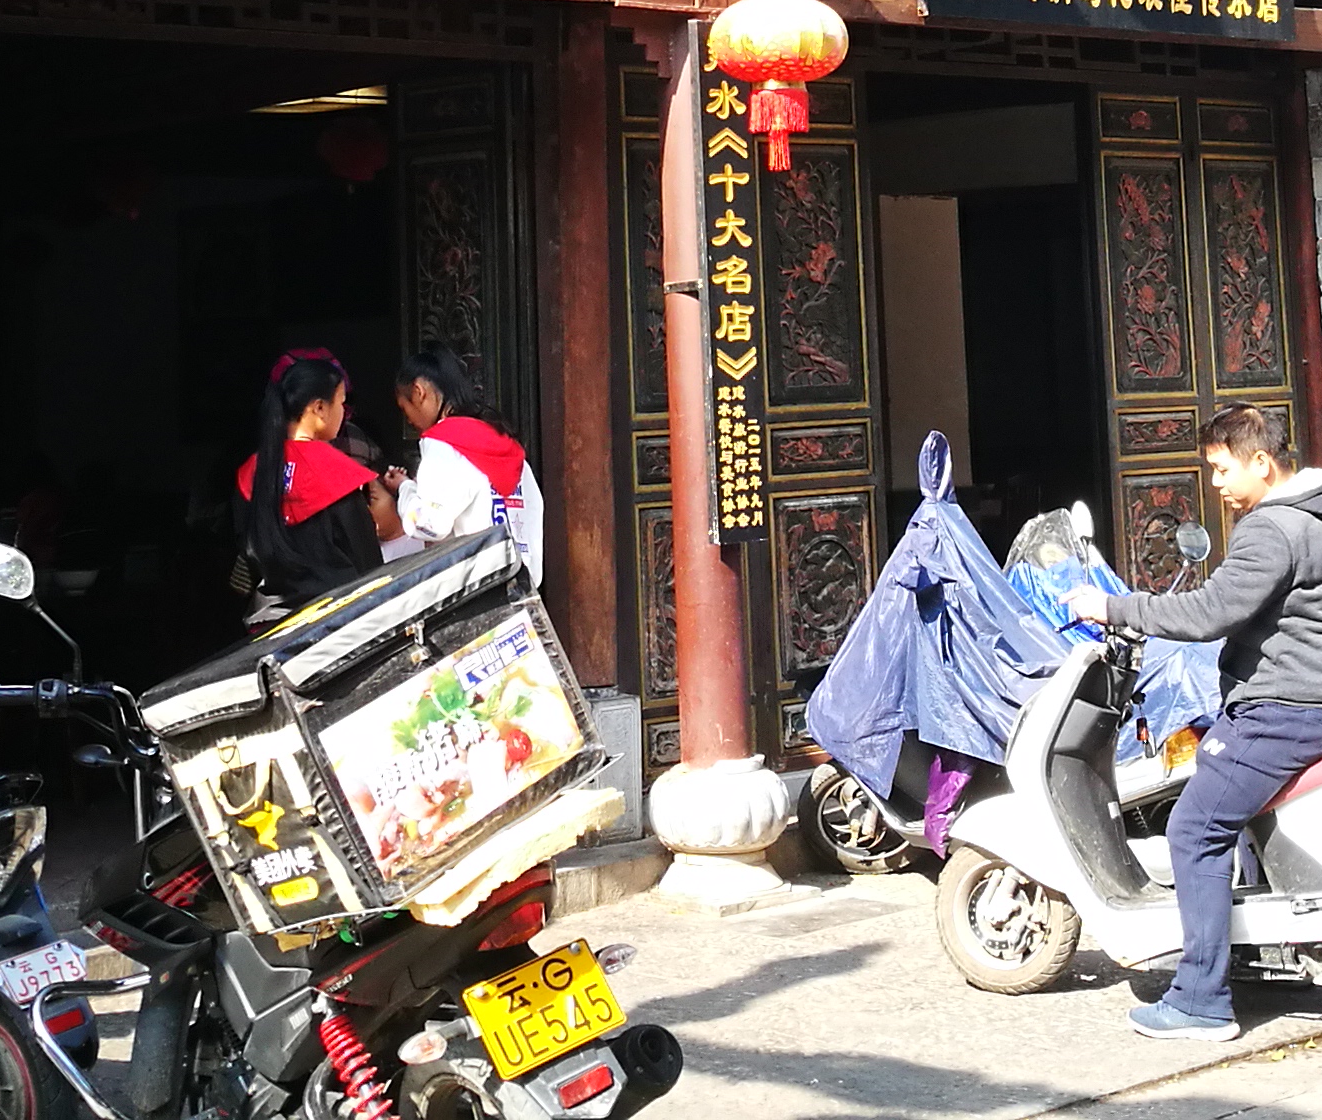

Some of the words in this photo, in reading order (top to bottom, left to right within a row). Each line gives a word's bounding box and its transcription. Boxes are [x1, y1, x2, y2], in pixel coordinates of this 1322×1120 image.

[251, 846, 318, 887] 美团外卖
[18, 960, 80, 997] J9773
[494, 983, 613, 1067] UE545
